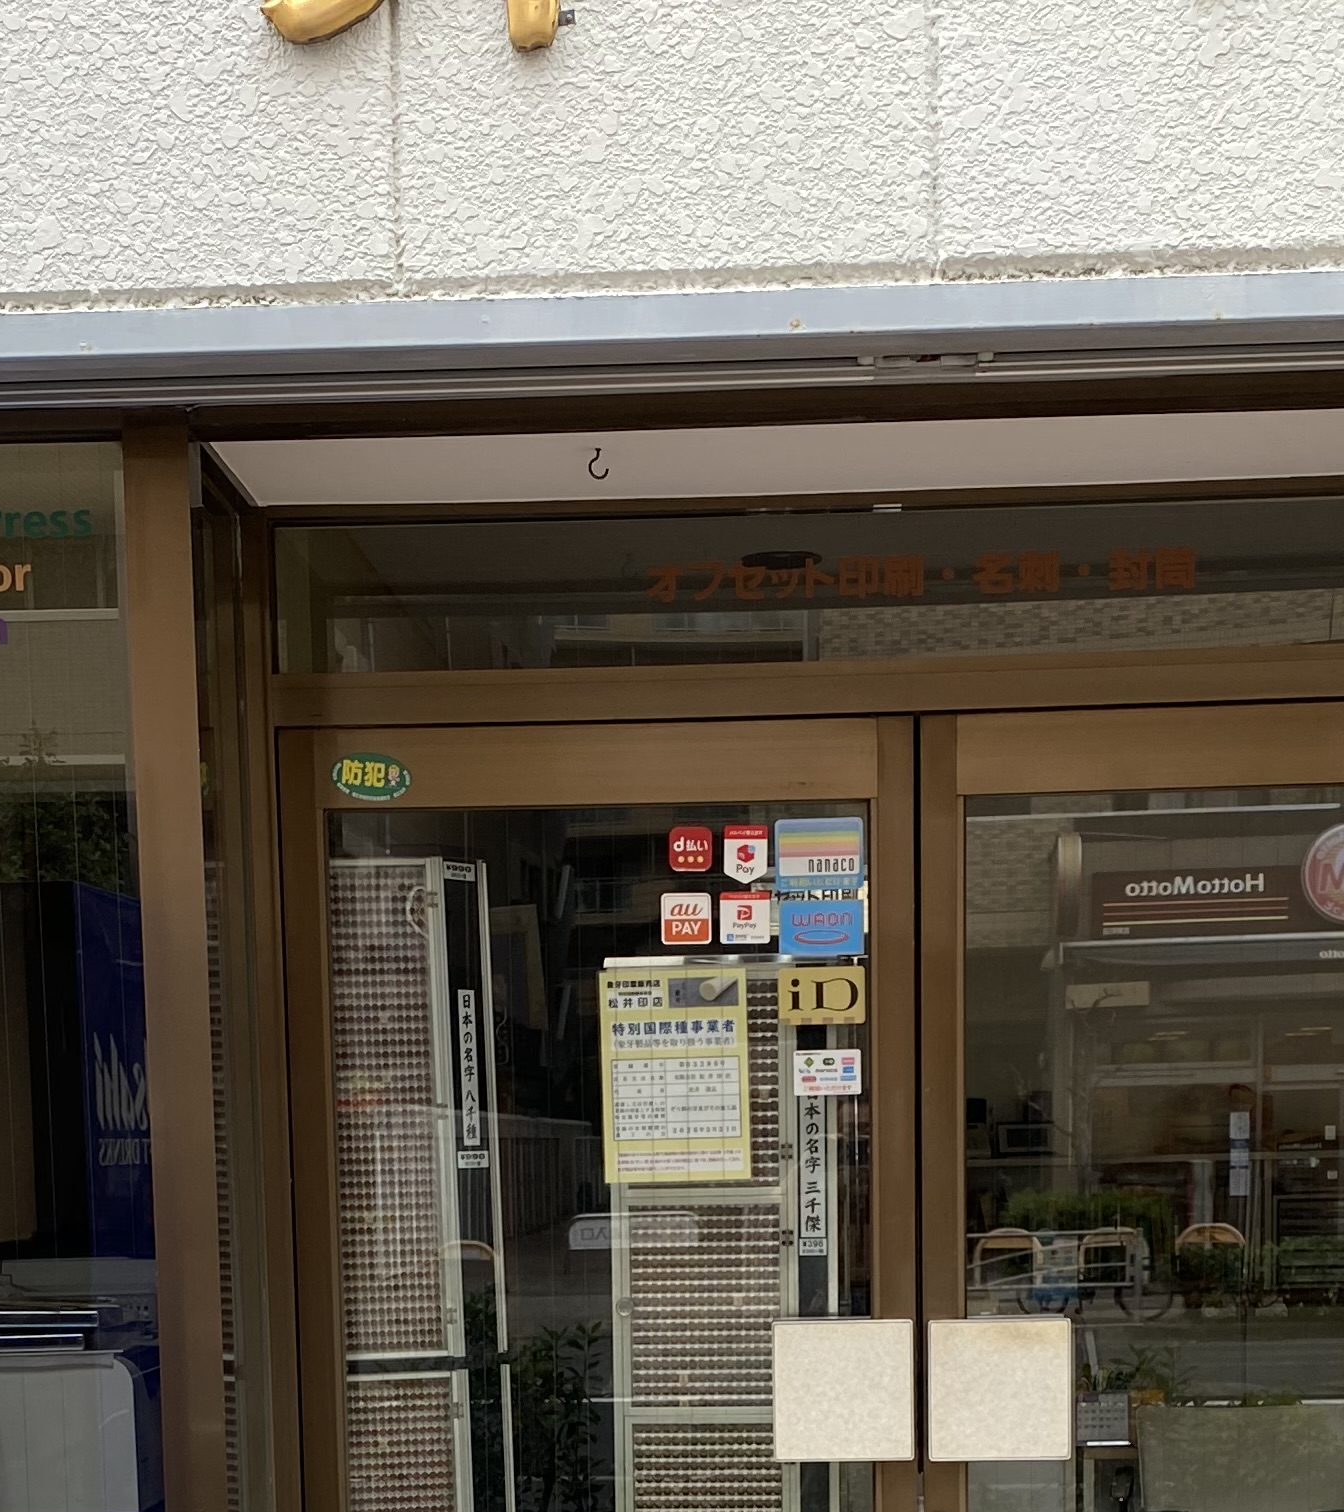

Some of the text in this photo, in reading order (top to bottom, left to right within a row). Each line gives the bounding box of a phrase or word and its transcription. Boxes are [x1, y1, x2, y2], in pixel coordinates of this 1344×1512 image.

[341, 759, 386, 788] 防犯
[672, 836, 709, 852] d払い
[735, 863, 755, 876] Pay
[807, 857, 856, 874] nanaco
[670, 902, 704, 917] au
[671, 921, 702, 936] PAY
[732, 922, 757, 930] PayPay
[787, 977, 860, 1012] iD
[608, 997, 663, 1009] 松井印店
[611, 1019, 736, 1036] 特別国際種事業者
[461, 993, 476, 1083] 日本の名字
